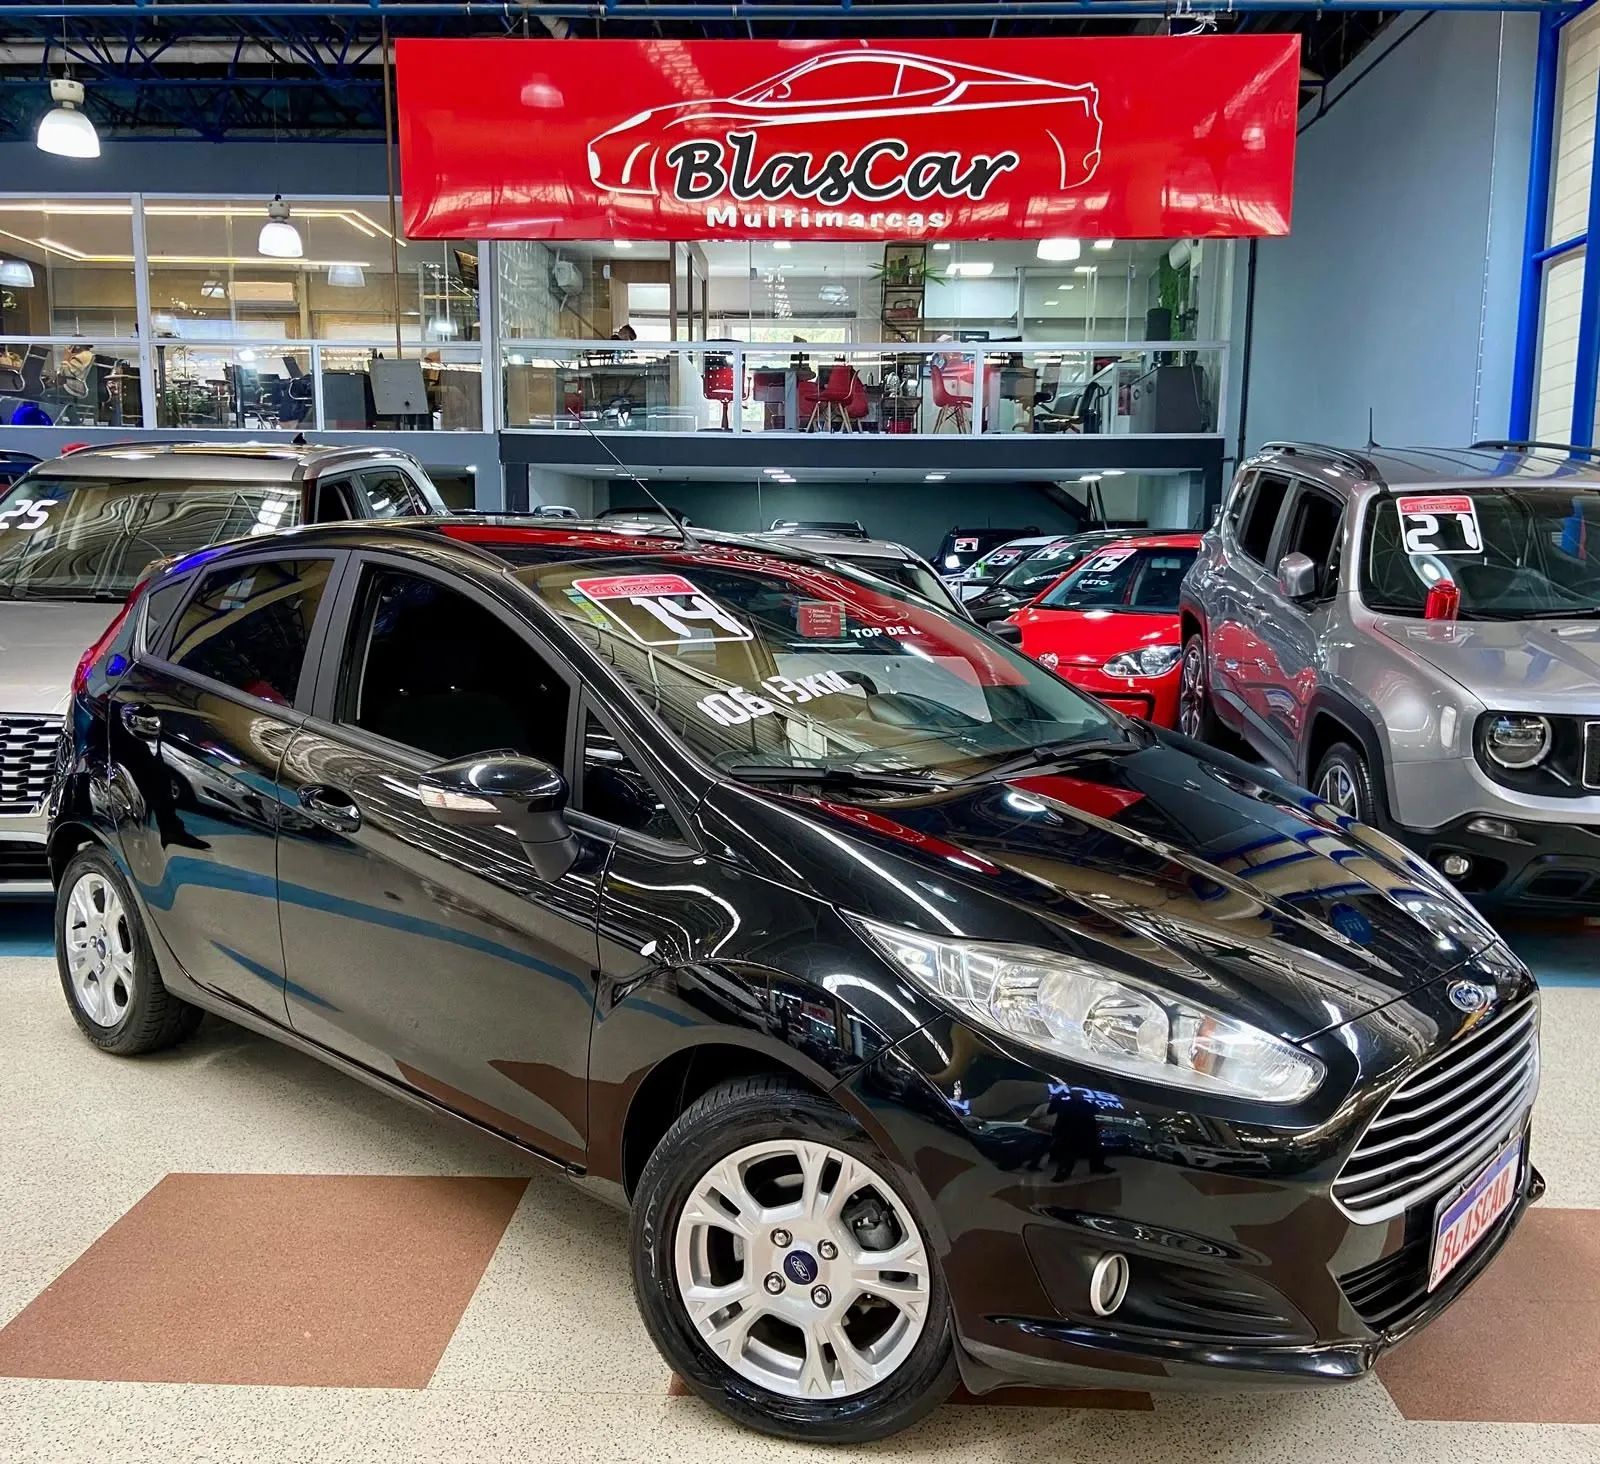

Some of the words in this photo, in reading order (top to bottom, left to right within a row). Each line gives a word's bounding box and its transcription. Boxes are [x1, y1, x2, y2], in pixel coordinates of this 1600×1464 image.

[667, 131, 1020, 206] BlasCar
[706, 206, 945, 229] Multimarcas
[0, 499, 58, 530] 25
[1406, 513, 1478, 551] 21
[1092, 555, 1127, 573] 15
[629, 596, 743, 638] 14
[851, 628, 882, 639] TOP
[886, 625, 909, 636] DE
[1440, 1166, 1511, 1274] BLASCAR
